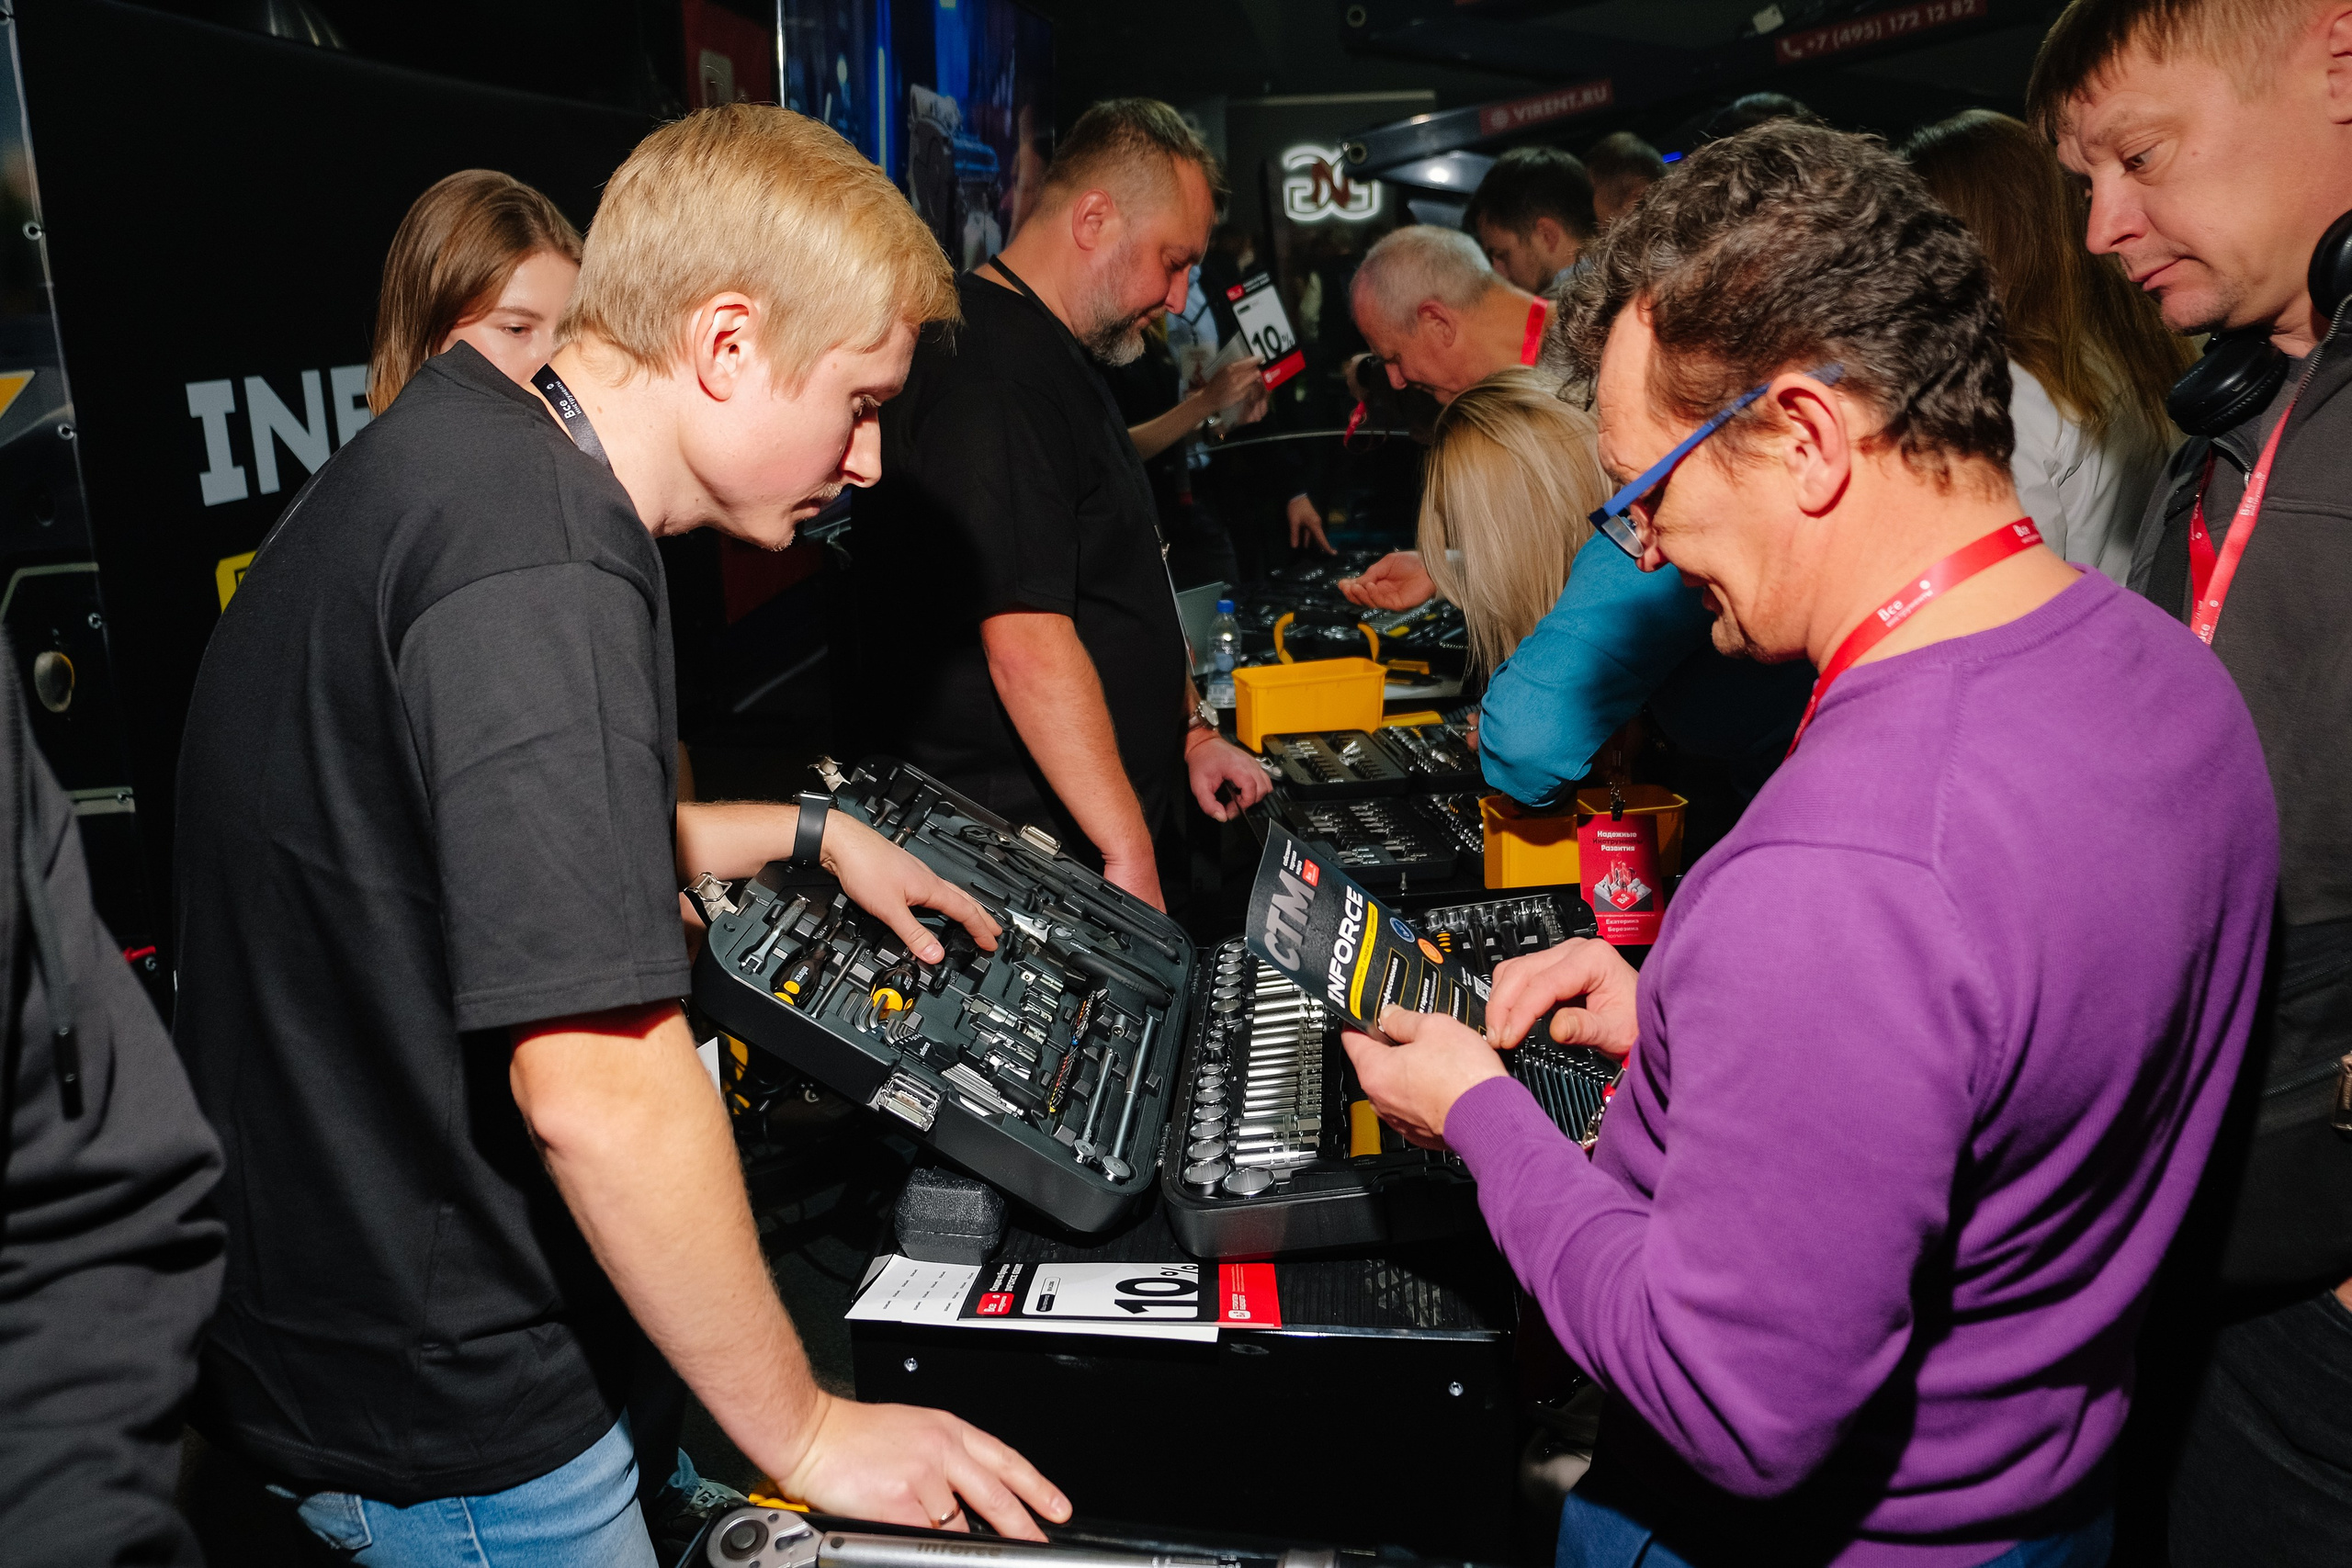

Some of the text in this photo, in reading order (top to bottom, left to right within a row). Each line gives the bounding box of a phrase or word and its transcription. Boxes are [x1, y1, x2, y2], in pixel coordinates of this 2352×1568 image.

[554, 379, 582, 415] инструменты
[560, 399, 577, 420] Все
[1876, 599, 1905, 623] Все
[1596, 830, 1637, 839] Надежные
[1327, 885, 1363, 1010] INFORCE
[1114, 1265, 1199, 1314] 10%
